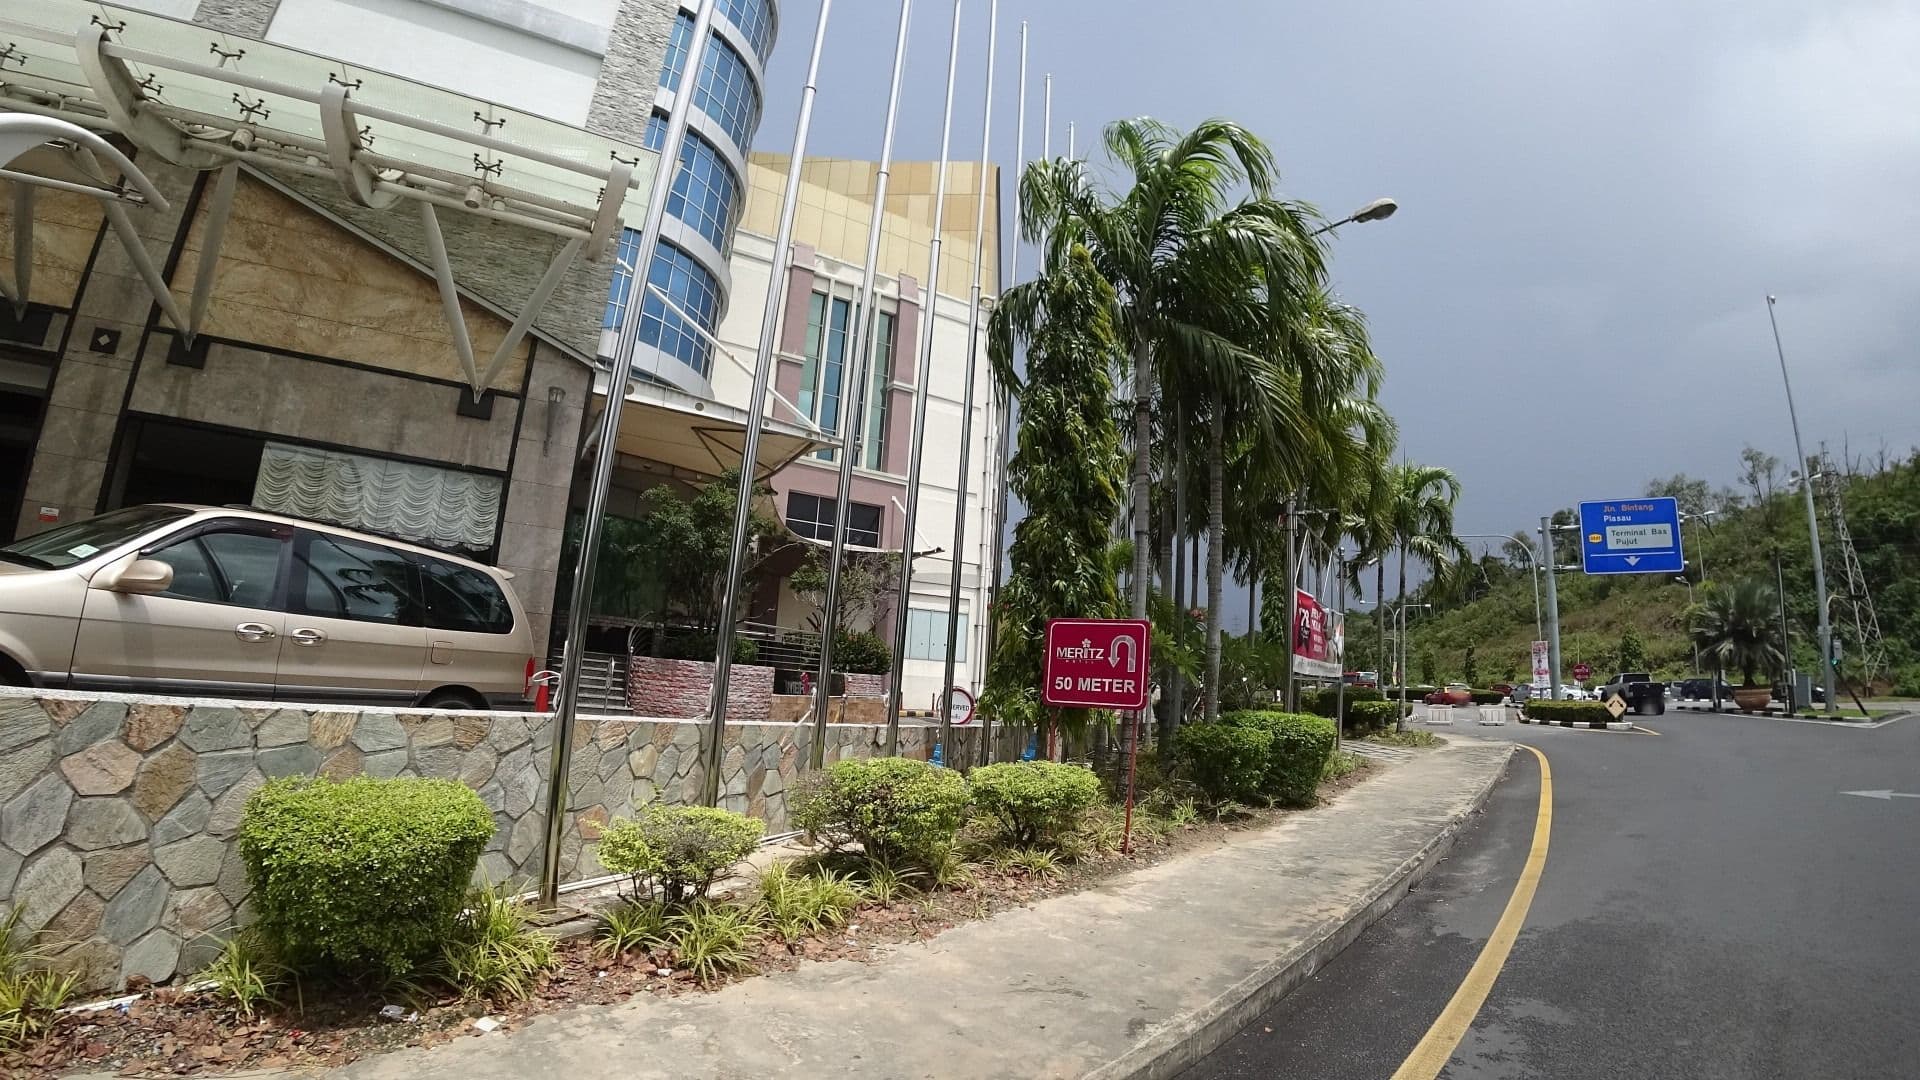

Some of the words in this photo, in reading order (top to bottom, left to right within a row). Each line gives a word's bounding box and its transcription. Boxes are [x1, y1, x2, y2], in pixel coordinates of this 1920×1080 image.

[1621, 504, 1654, 512] Bintang
[1611, 529, 1646, 537] Terminal
[1616, 538, 1638, 546] Pujut
[1056, 645, 1104, 659] MERITZ
[1055, 676, 1073, 691] 50
[1077, 677, 1136, 694] METER
